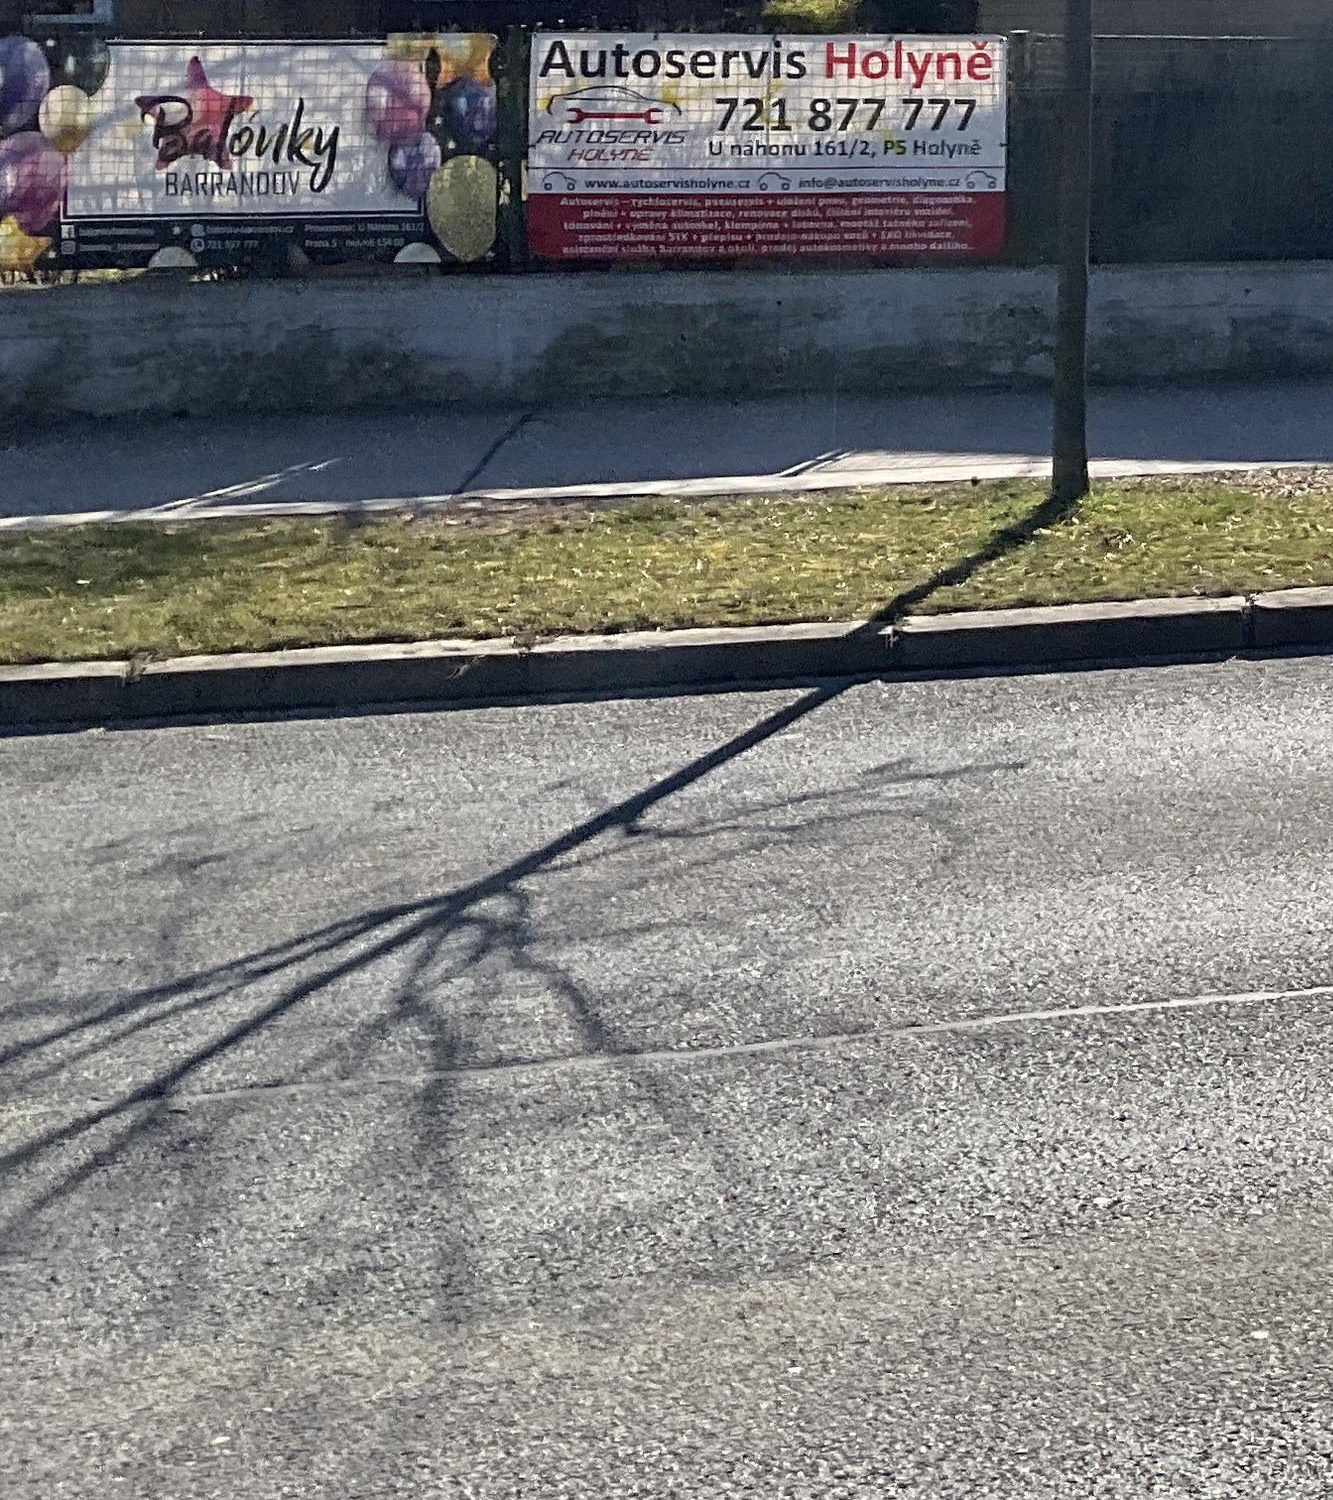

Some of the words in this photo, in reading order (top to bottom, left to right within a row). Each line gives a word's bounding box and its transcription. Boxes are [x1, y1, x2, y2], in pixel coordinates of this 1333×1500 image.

[538, 40, 807, 79] Autoservis
[825, 40, 993, 89] Holyně
[714, 97, 791, 132] 721
[808, 97, 886, 132] 877
[902, 97, 978, 131] 777
[135, 96, 341, 194] Balónky
[536, 130, 687, 144] AUTOSERVIS
[708, 139, 723, 156] U
[813, 139, 877, 159] 161/2,
[883, 140, 908, 157] P5
[913, 139, 982, 160] Holyně
[165, 172, 301, 196] BARRANDOV
[584, 177, 751, 192] www.autoservisholyne.cz
